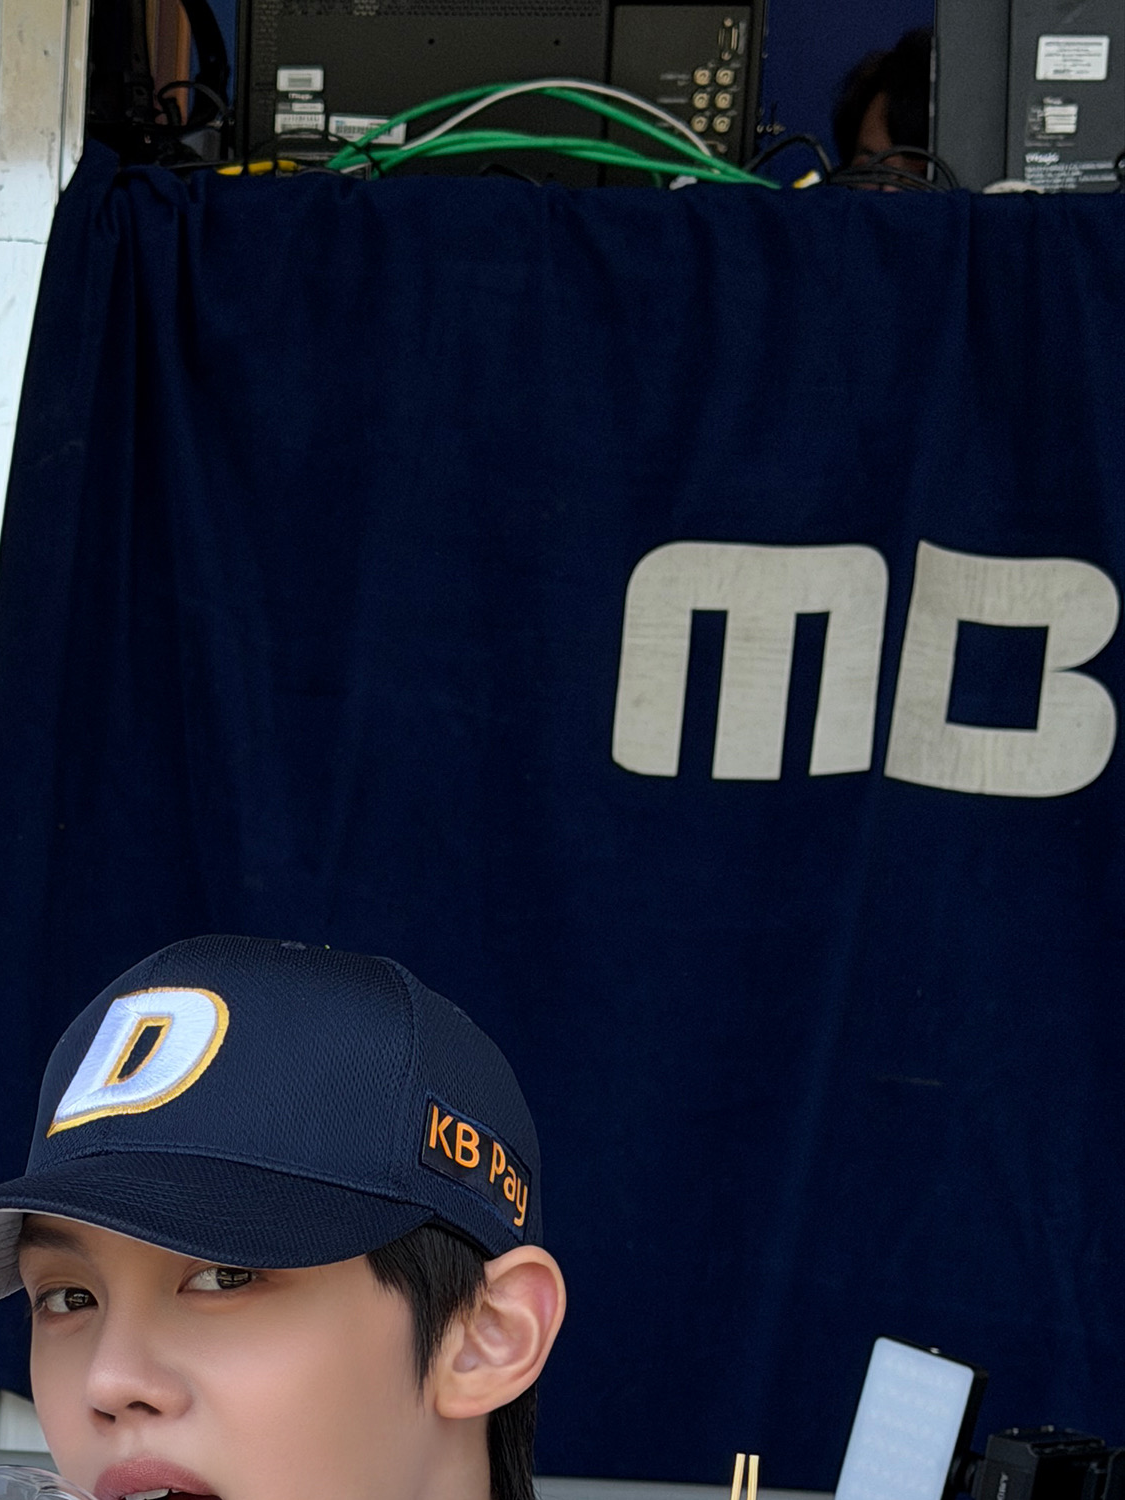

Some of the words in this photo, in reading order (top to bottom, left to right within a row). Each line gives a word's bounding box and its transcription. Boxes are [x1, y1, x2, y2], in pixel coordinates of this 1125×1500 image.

[611, 539, 1120, 798] MB
[46, 986, 229, 1138] D
[429, 1105, 480, 1169] KB
[489, 1140, 528, 1227] Pay
